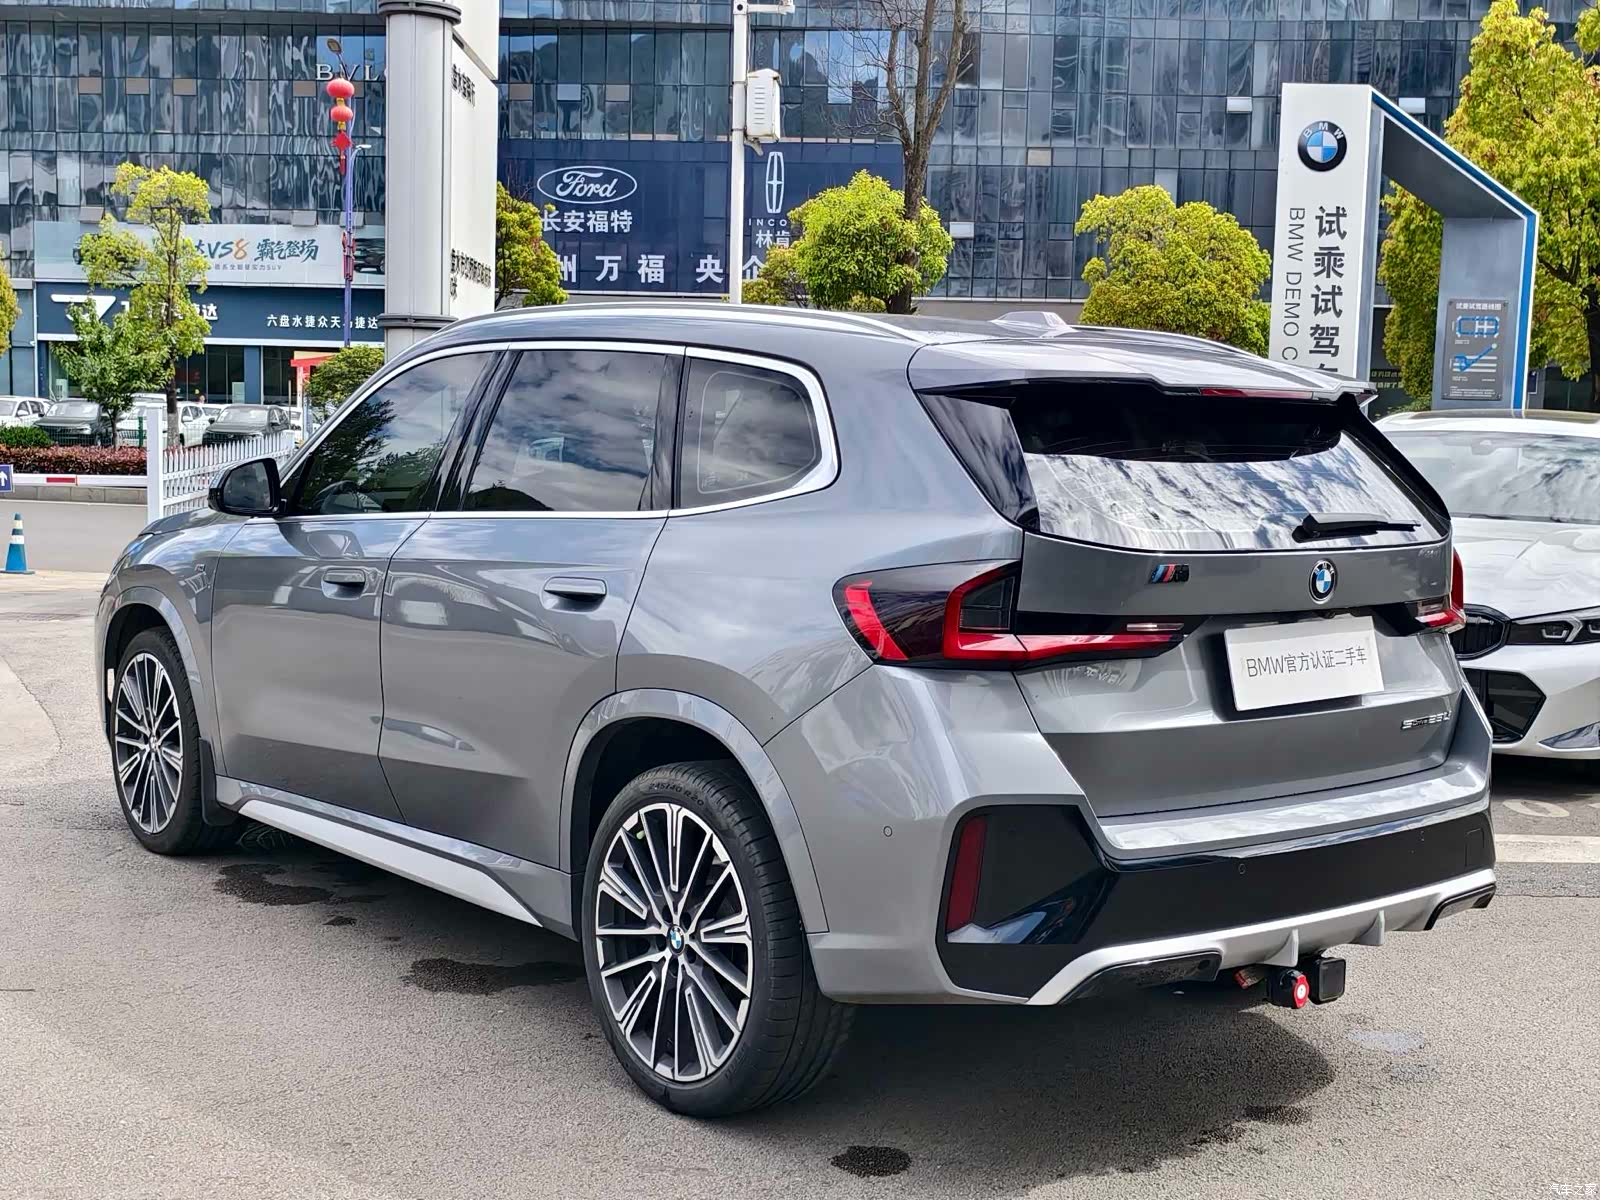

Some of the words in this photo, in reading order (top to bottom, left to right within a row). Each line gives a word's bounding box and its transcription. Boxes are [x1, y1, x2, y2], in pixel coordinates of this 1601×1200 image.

[316, 63, 388, 81] BVL
[1302, 121, 1346, 141] BMW
[555, 169, 618, 198] Ford
[541, 209, 633, 234] 长安福特
[1287, 207, 1306, 262] BMW
[254, 238, 319, 263] 霸气登场
[755, 229, 791, 249] 林肯
[1308, 206, 1349, 374] 试乘试驾
[1281, 272, 1302, 337] DEMO
[1246, 645, 1368, 679] BMW官方认证二手车
